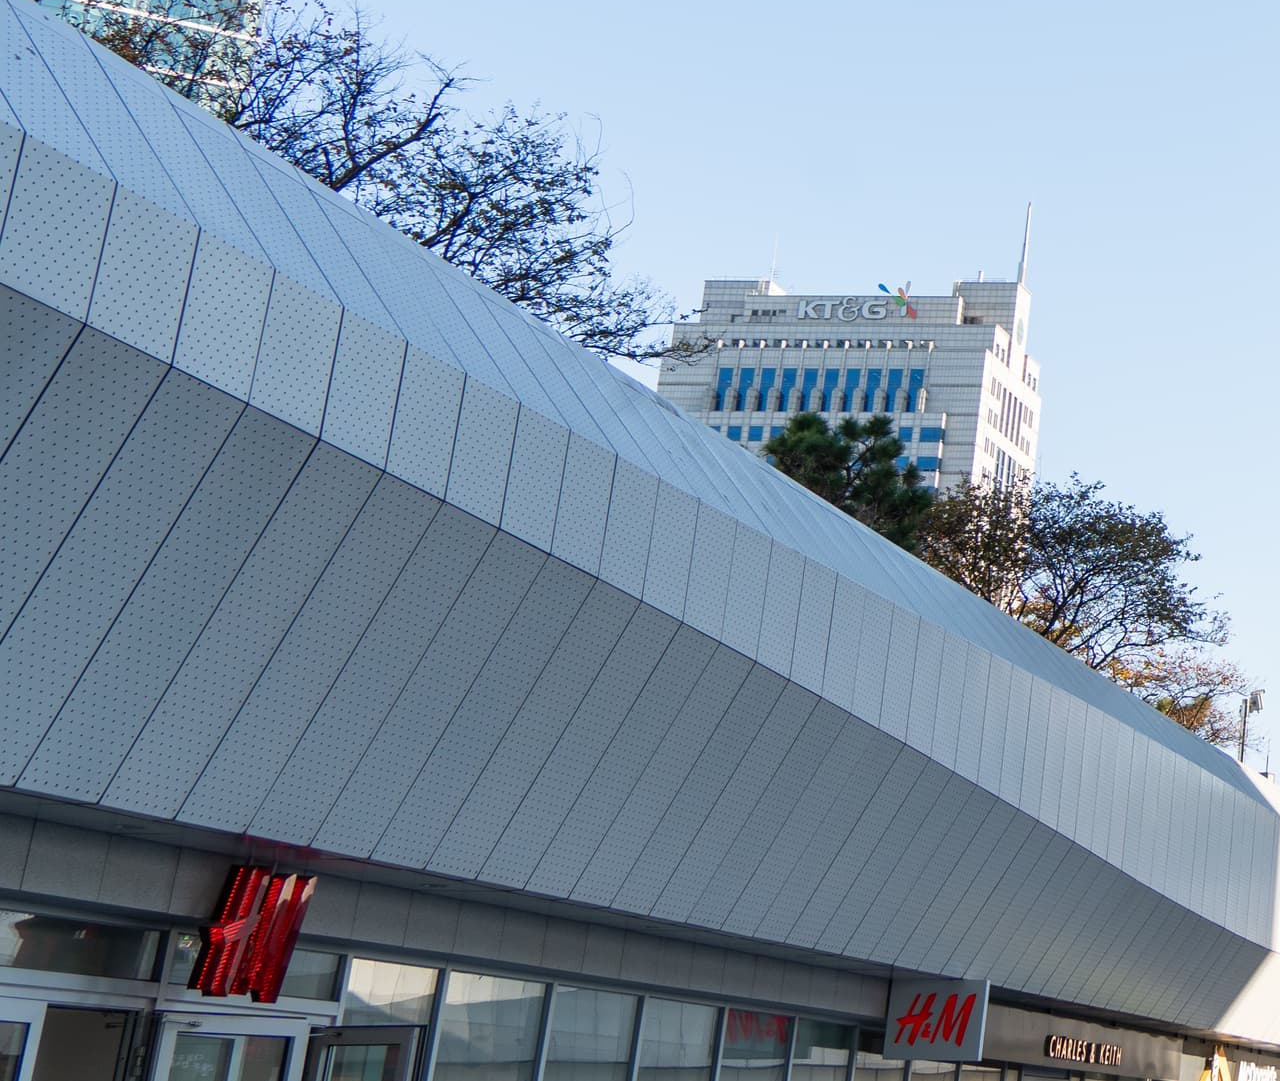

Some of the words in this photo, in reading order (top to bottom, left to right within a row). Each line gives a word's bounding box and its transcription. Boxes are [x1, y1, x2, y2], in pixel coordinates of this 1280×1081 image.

[798, 296, 888, 322] KT&G
[894, 992, 977, 1047] H&M
[1049, 1035, 1088, 1063] CHARLES
[1089, 1041, 1096, 1064] &
[1099, 1043, 1123, 1067] KEITH
